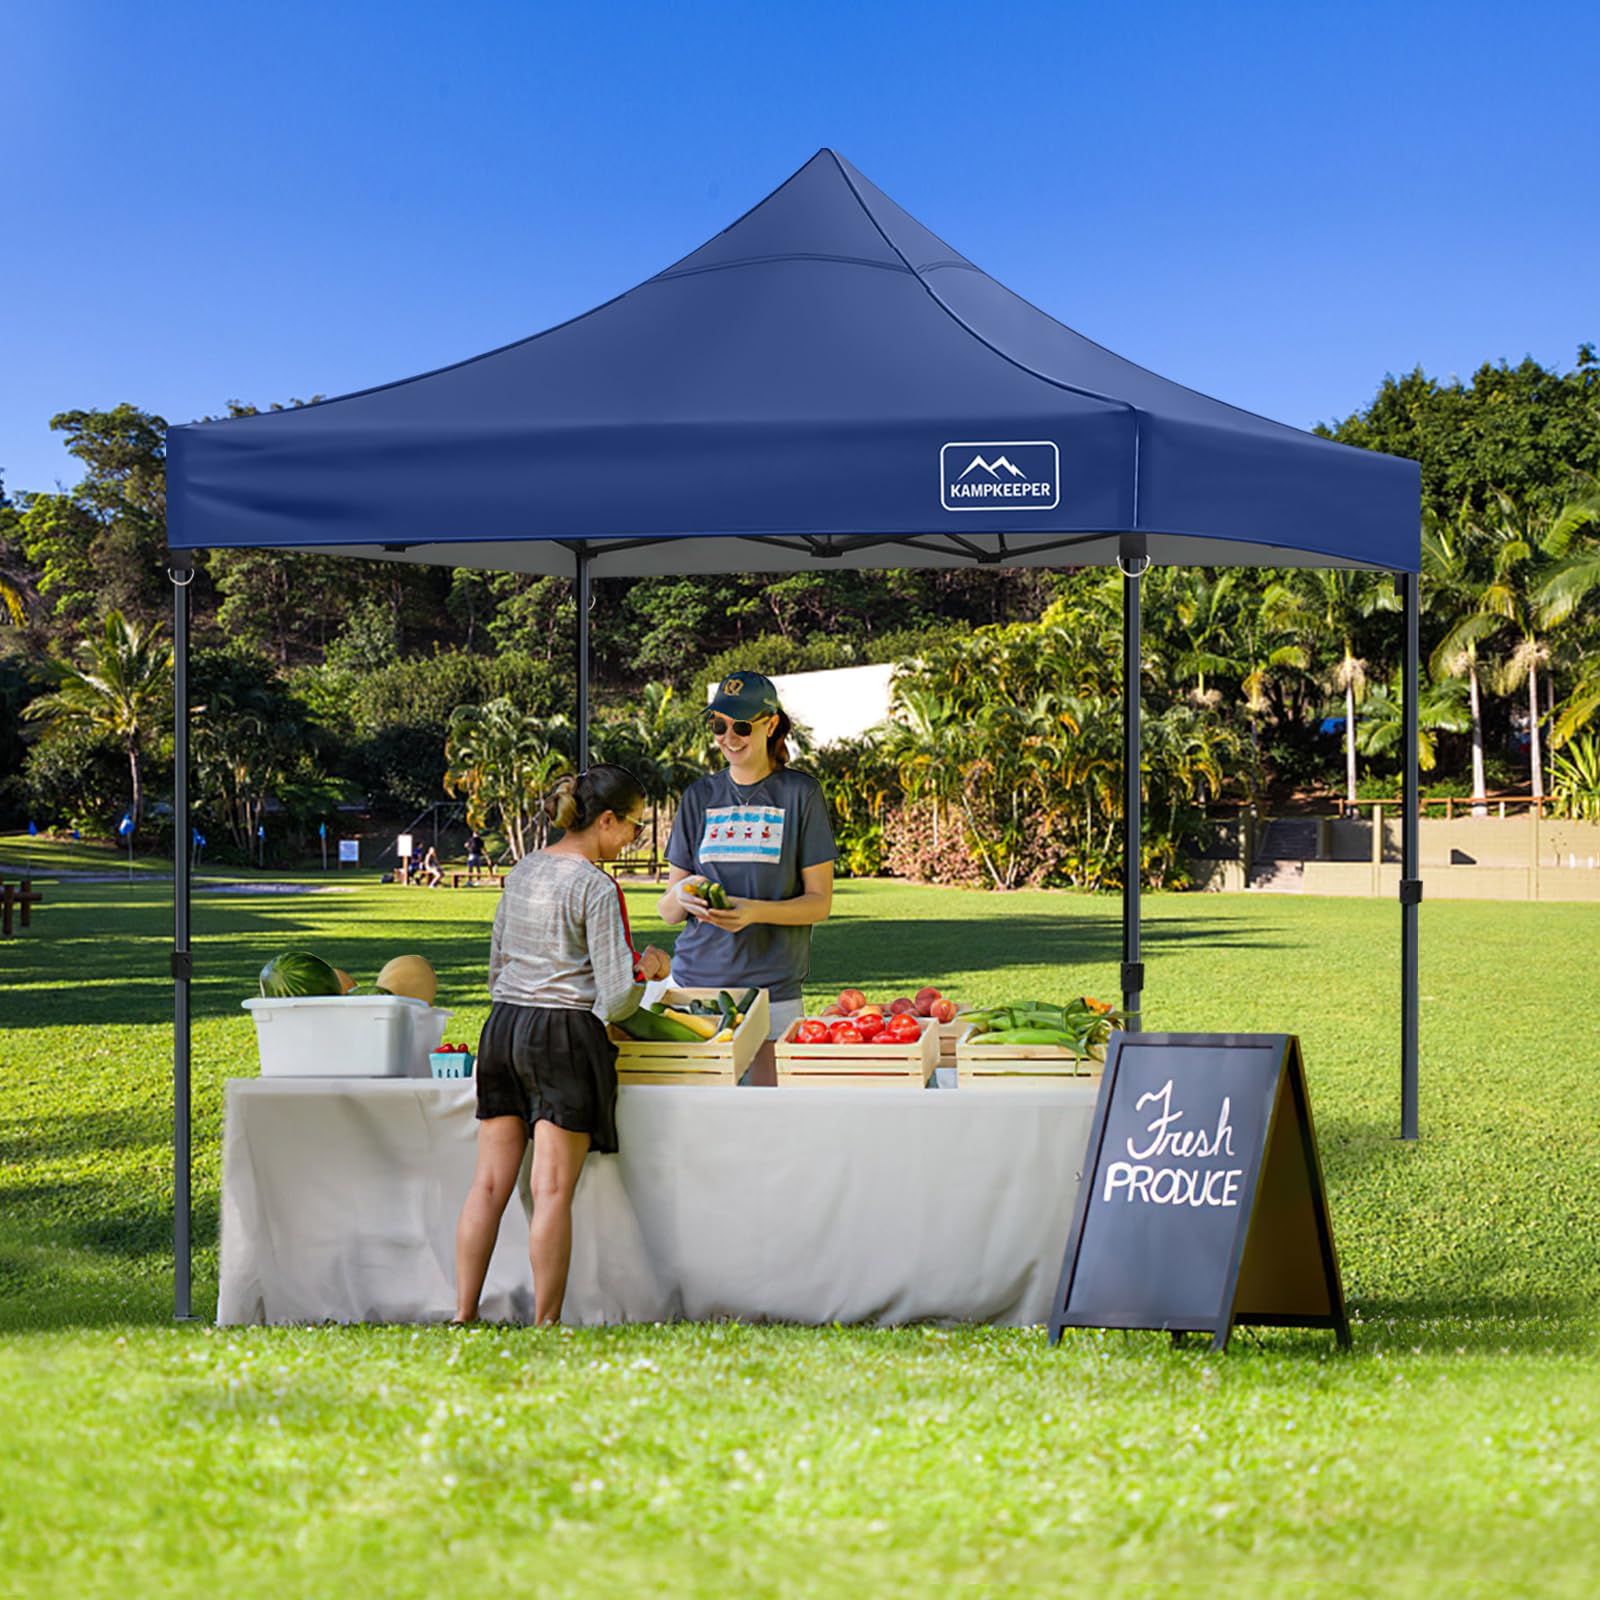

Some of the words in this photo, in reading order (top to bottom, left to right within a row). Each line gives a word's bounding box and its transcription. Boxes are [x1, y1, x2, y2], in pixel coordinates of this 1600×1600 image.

[950, 482, 1051, 498] KAMPKEEPER
[1127, 1079, 1235, 1160] Fresh
[1103, 1161, 1242, 1206] PRODUCE
